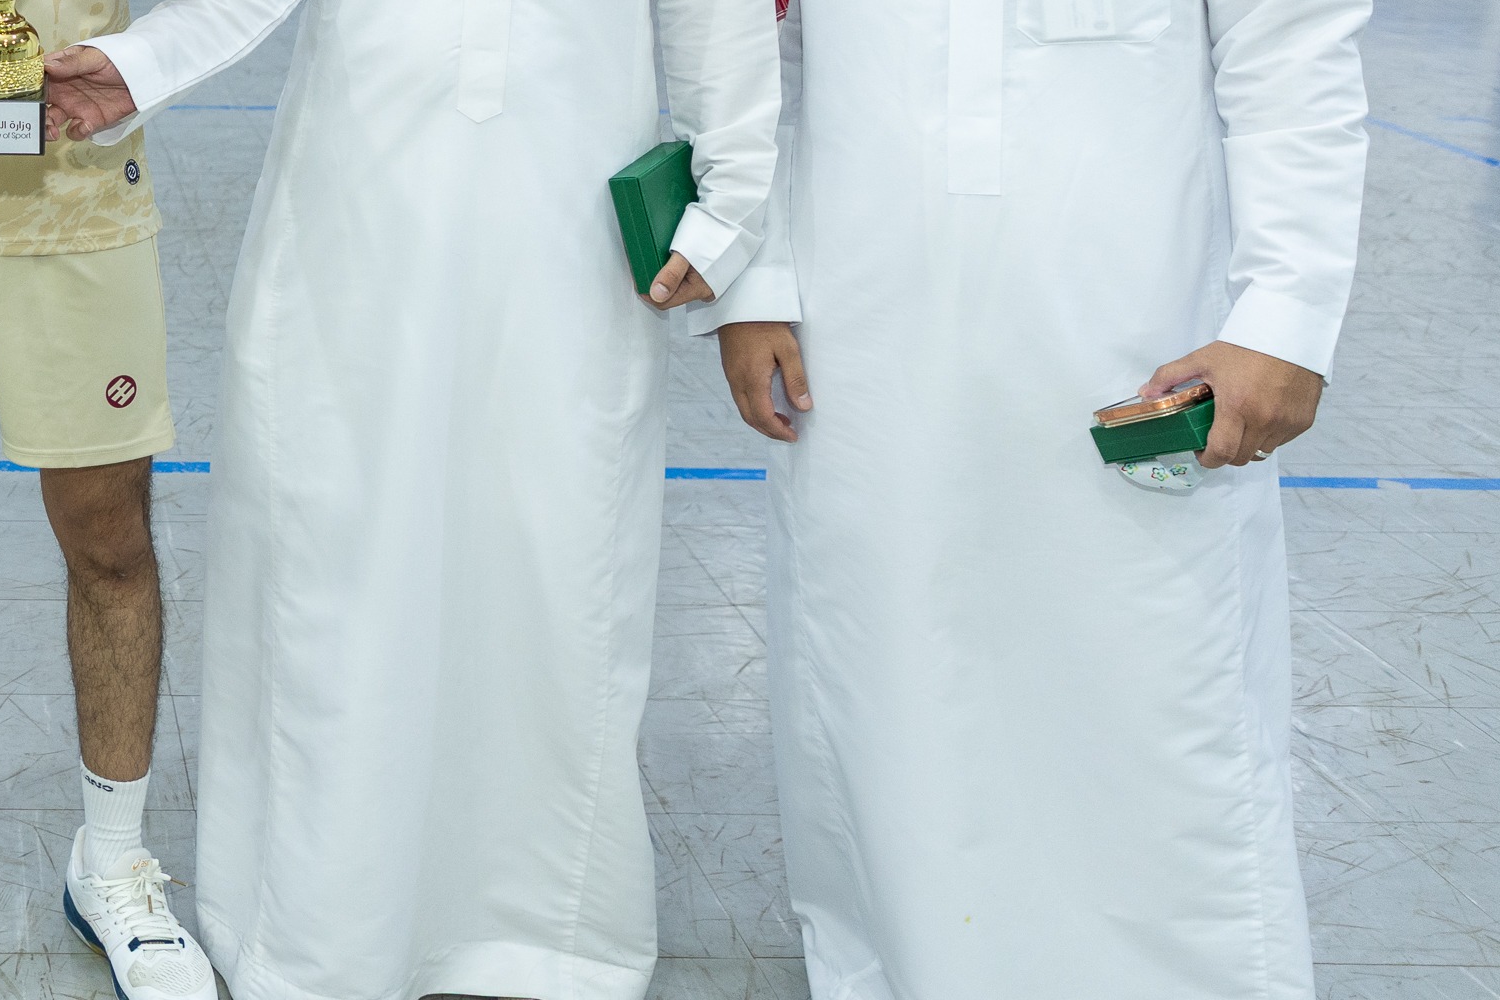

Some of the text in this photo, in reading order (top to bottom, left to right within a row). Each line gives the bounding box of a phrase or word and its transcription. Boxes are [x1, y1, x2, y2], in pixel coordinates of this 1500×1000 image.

[9, 121, 31, 131] وزارة
[3, 131, 11, 139] of
[11, 131, 31, 140] Sport
